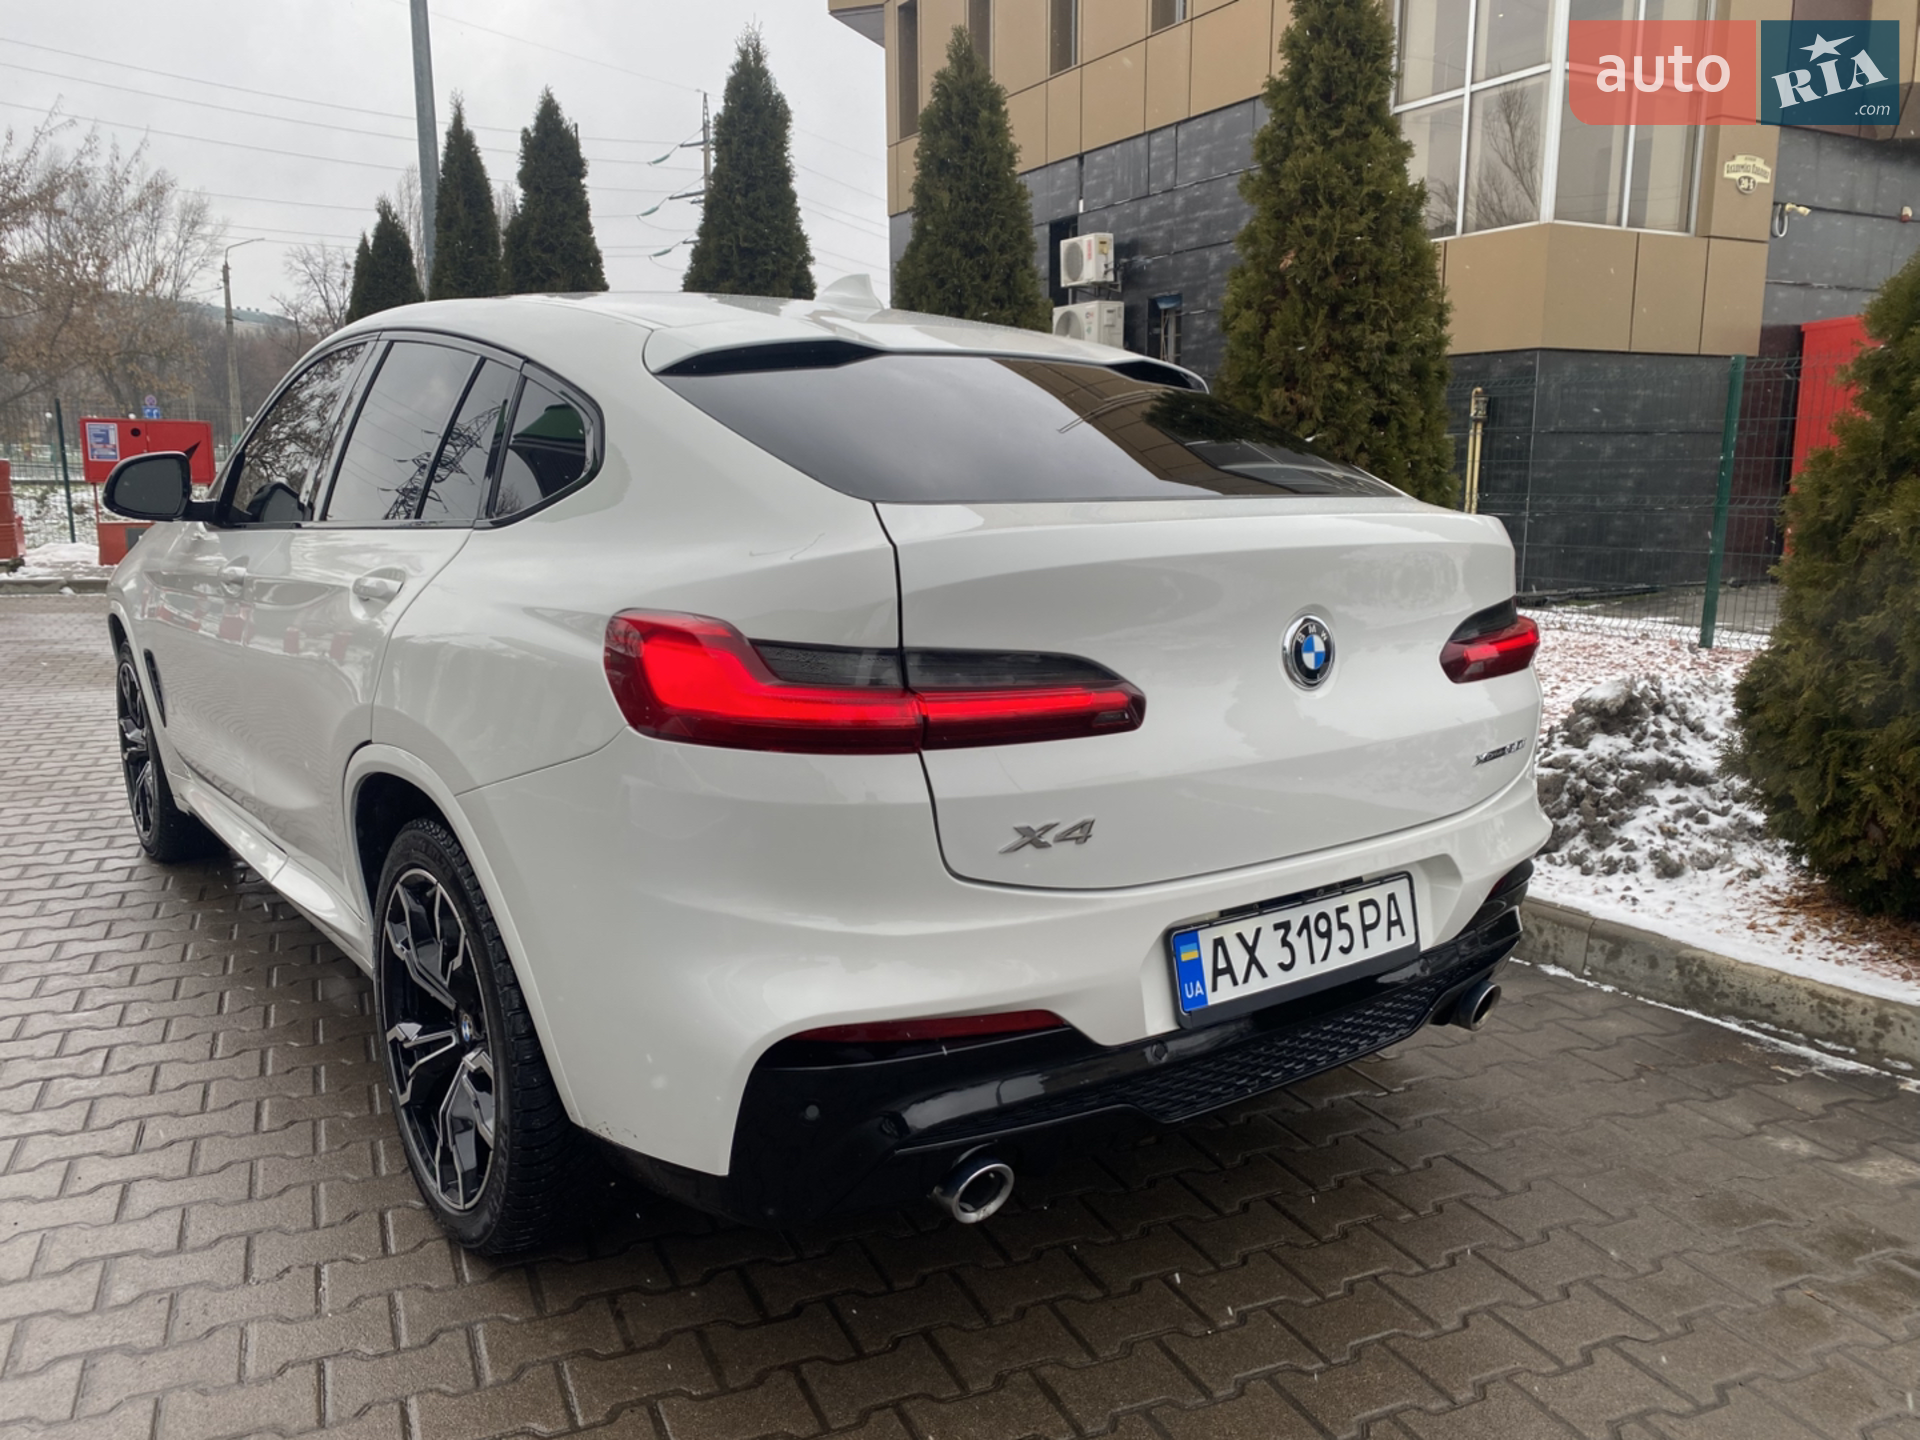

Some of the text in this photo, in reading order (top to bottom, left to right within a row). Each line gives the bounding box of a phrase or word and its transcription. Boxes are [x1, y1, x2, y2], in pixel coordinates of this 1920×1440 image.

[1296, 624, 1328, 643] BMW
[997, 816, 1096, 855] X4
[1211, 892, 1406, 993] AX 3195 PA
[1184, 981, 1205, 999] UA
